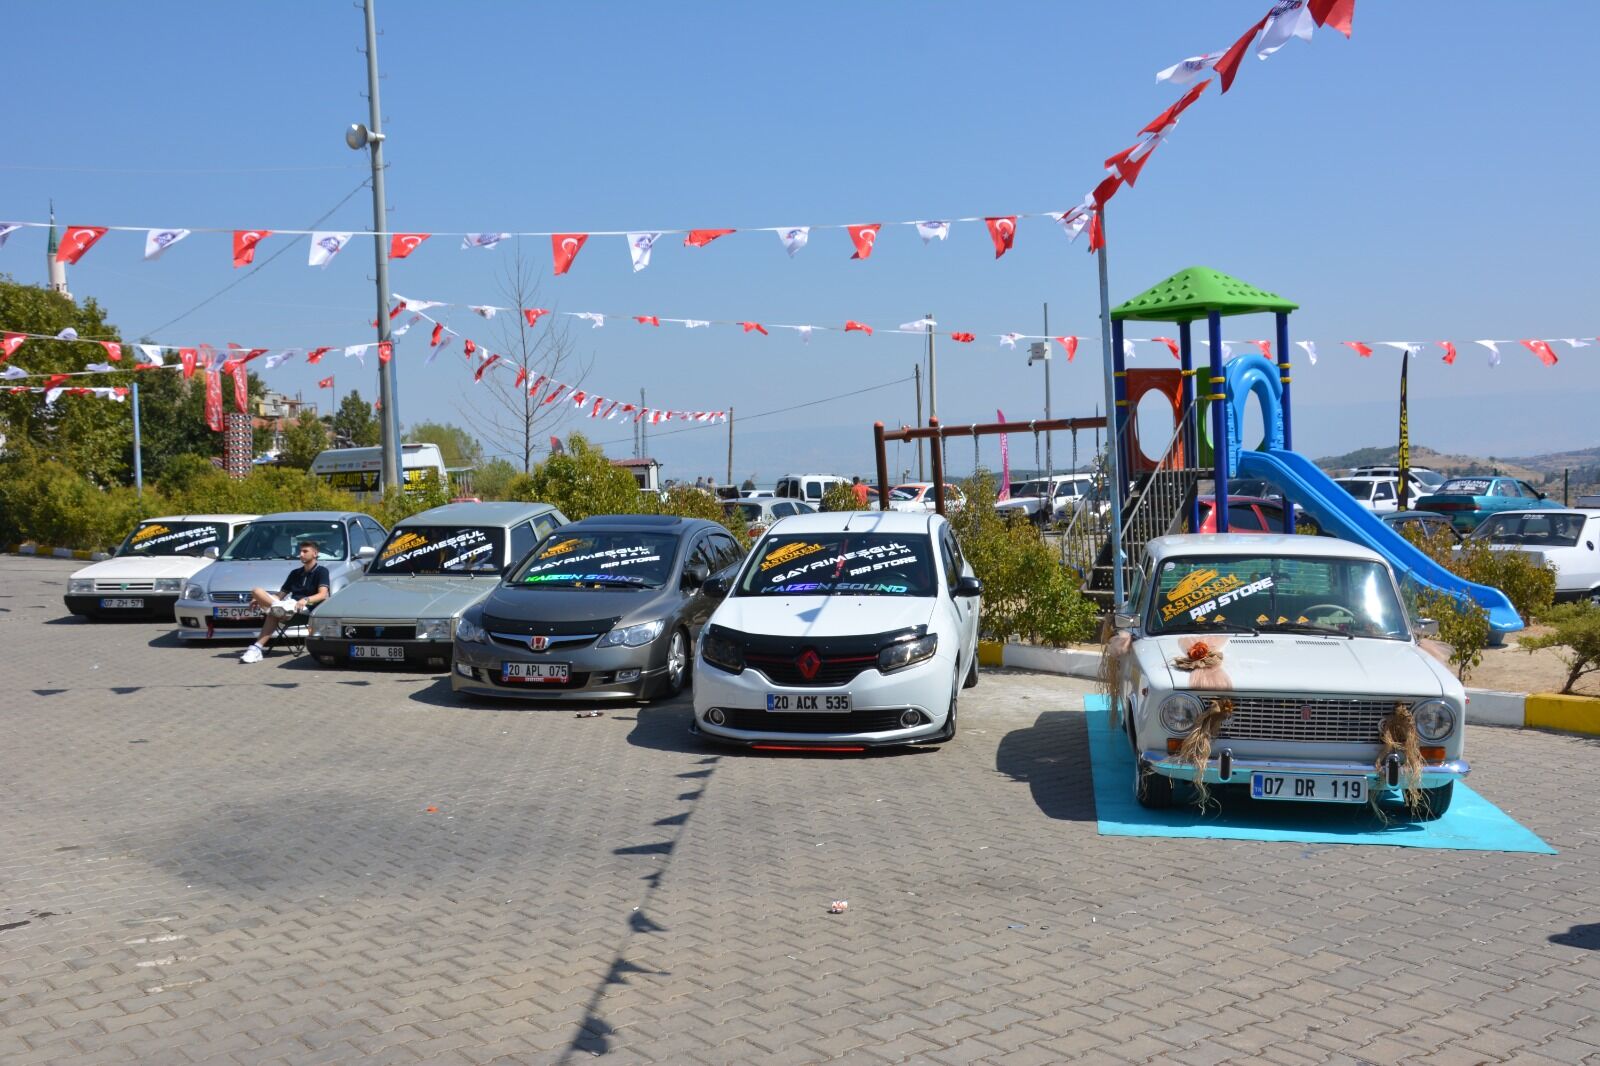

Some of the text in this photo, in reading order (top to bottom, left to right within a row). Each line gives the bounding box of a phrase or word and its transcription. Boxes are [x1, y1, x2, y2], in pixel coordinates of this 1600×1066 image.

[460, 543, 494, 562] STORE
[867, 548, 912, 561] TEAM
[620, 555, 661, 566] STORE
[871, 555, 918, 571] STORE
[525, 573, 644, 583] KAIZEN SOUND
[761, 582, 908, 593] KAIZEN SOUND
[1188, 599, 1217, 621] AIR
[1217, 576, 1275, 608] STORE
[219, 608, 229, 617] 35
[231, 608, 250, 617] CVC
[355, 647, 364, 656] 20
[370, 647, 380, 656] DL
[509, 664, 567, 677] 20 APL 075
[774, 695, 849, 710] 20 ACK 535
[1264, 778, 1284, 795] 07
[1295, 778, 1315, 797] DR
[1331, 780, 1361, 799] 119
